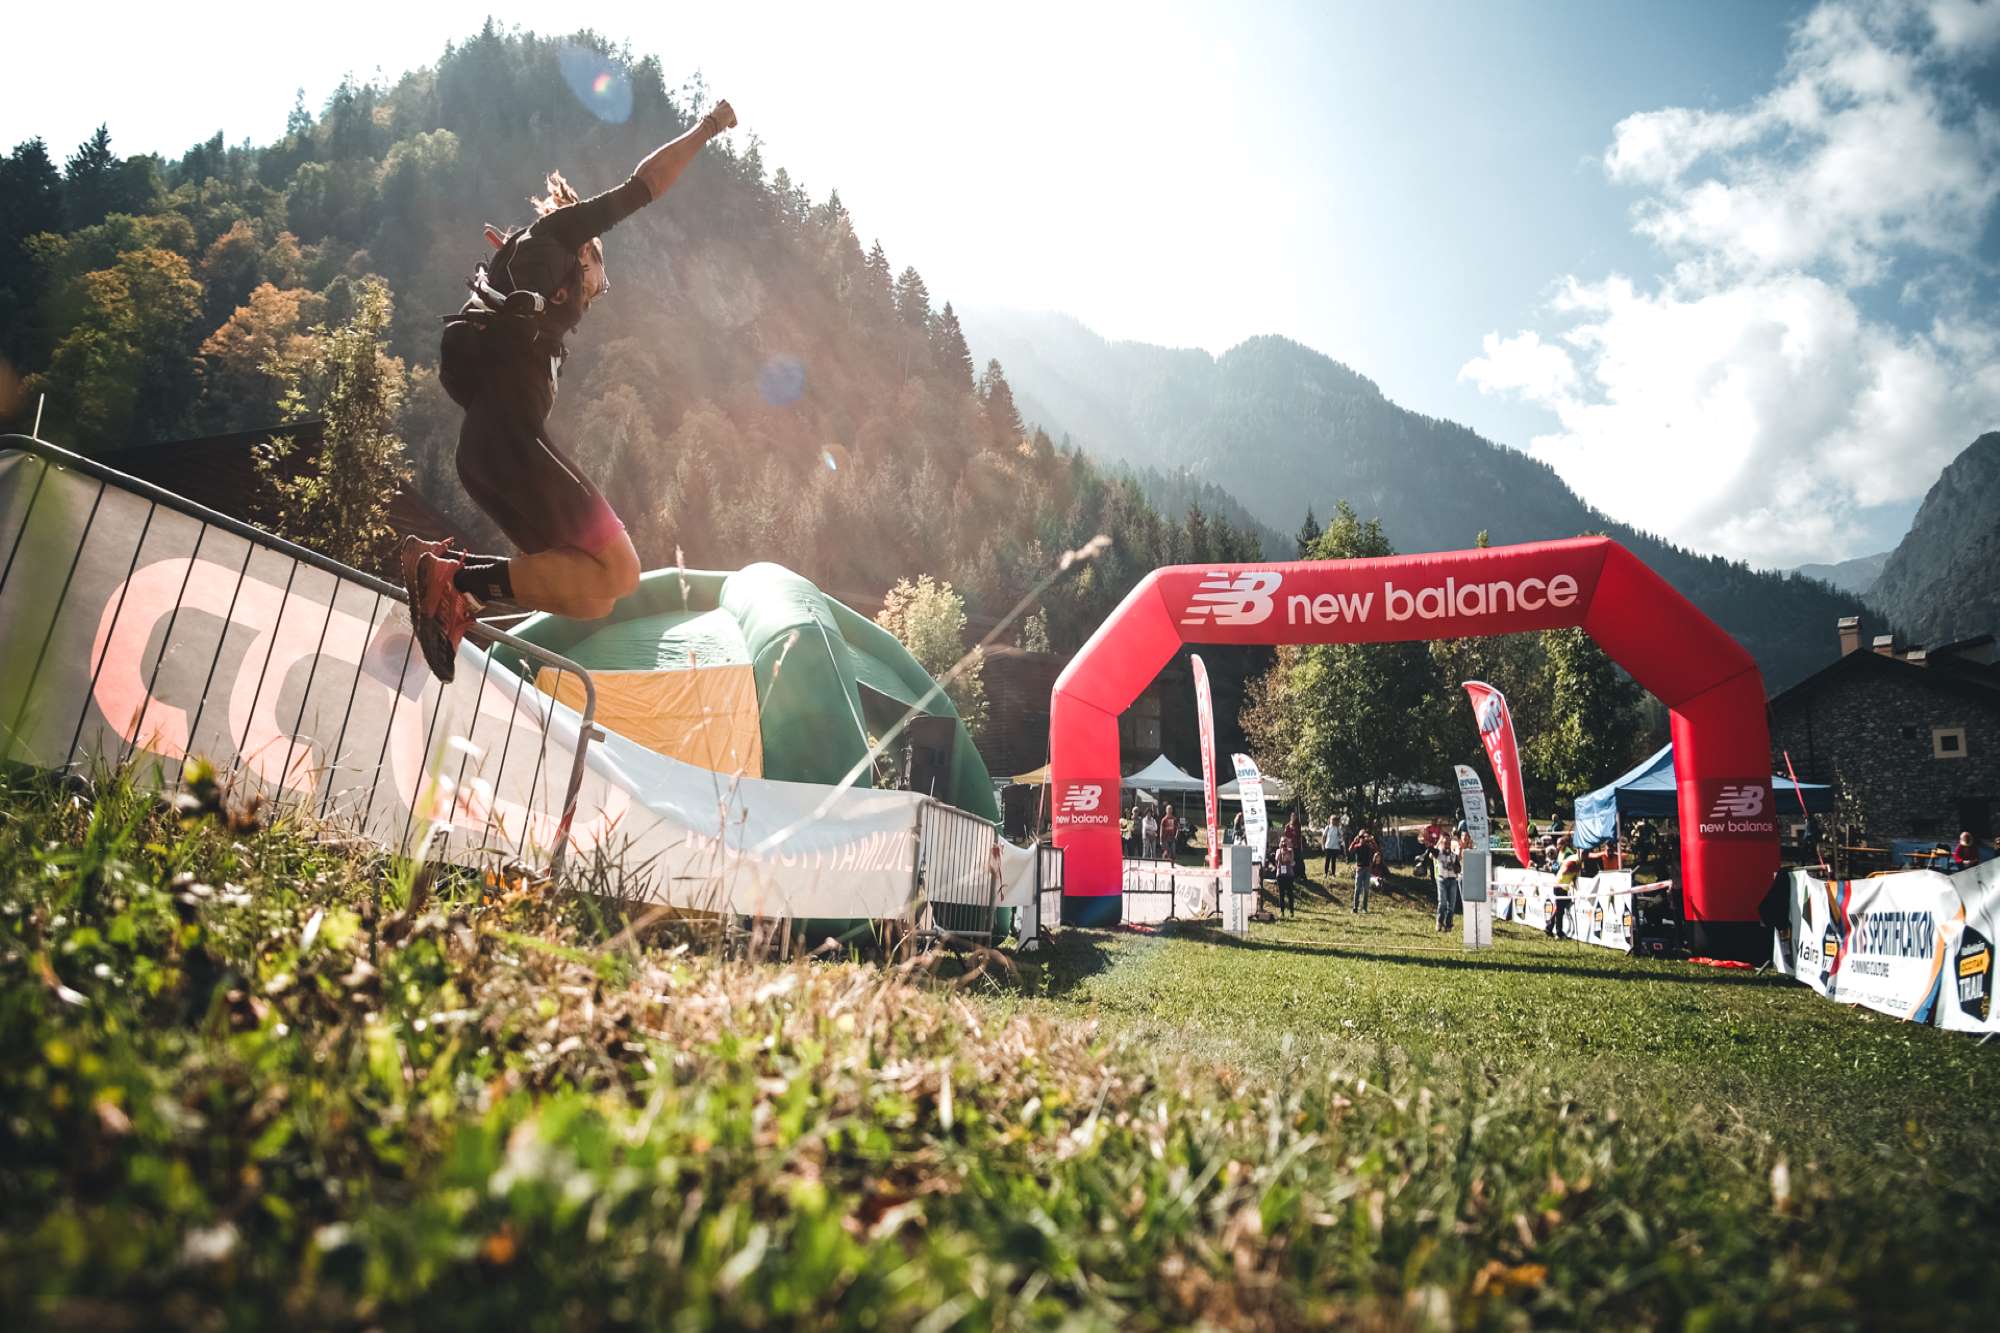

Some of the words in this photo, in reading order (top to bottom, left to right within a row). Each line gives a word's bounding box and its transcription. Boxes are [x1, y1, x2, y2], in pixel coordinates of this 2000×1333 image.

[1288, 593, 1374, 624] new
[1385, 574, 1578, 622] balance
[1056, 815, 1070, 824] new
[1072, 813, 1108, 824] balance
[1700, 823, 1725, 832] new
[1728, 820, 1773, 832] balance
[1959, 974, 1985, 1002] TRAIL
